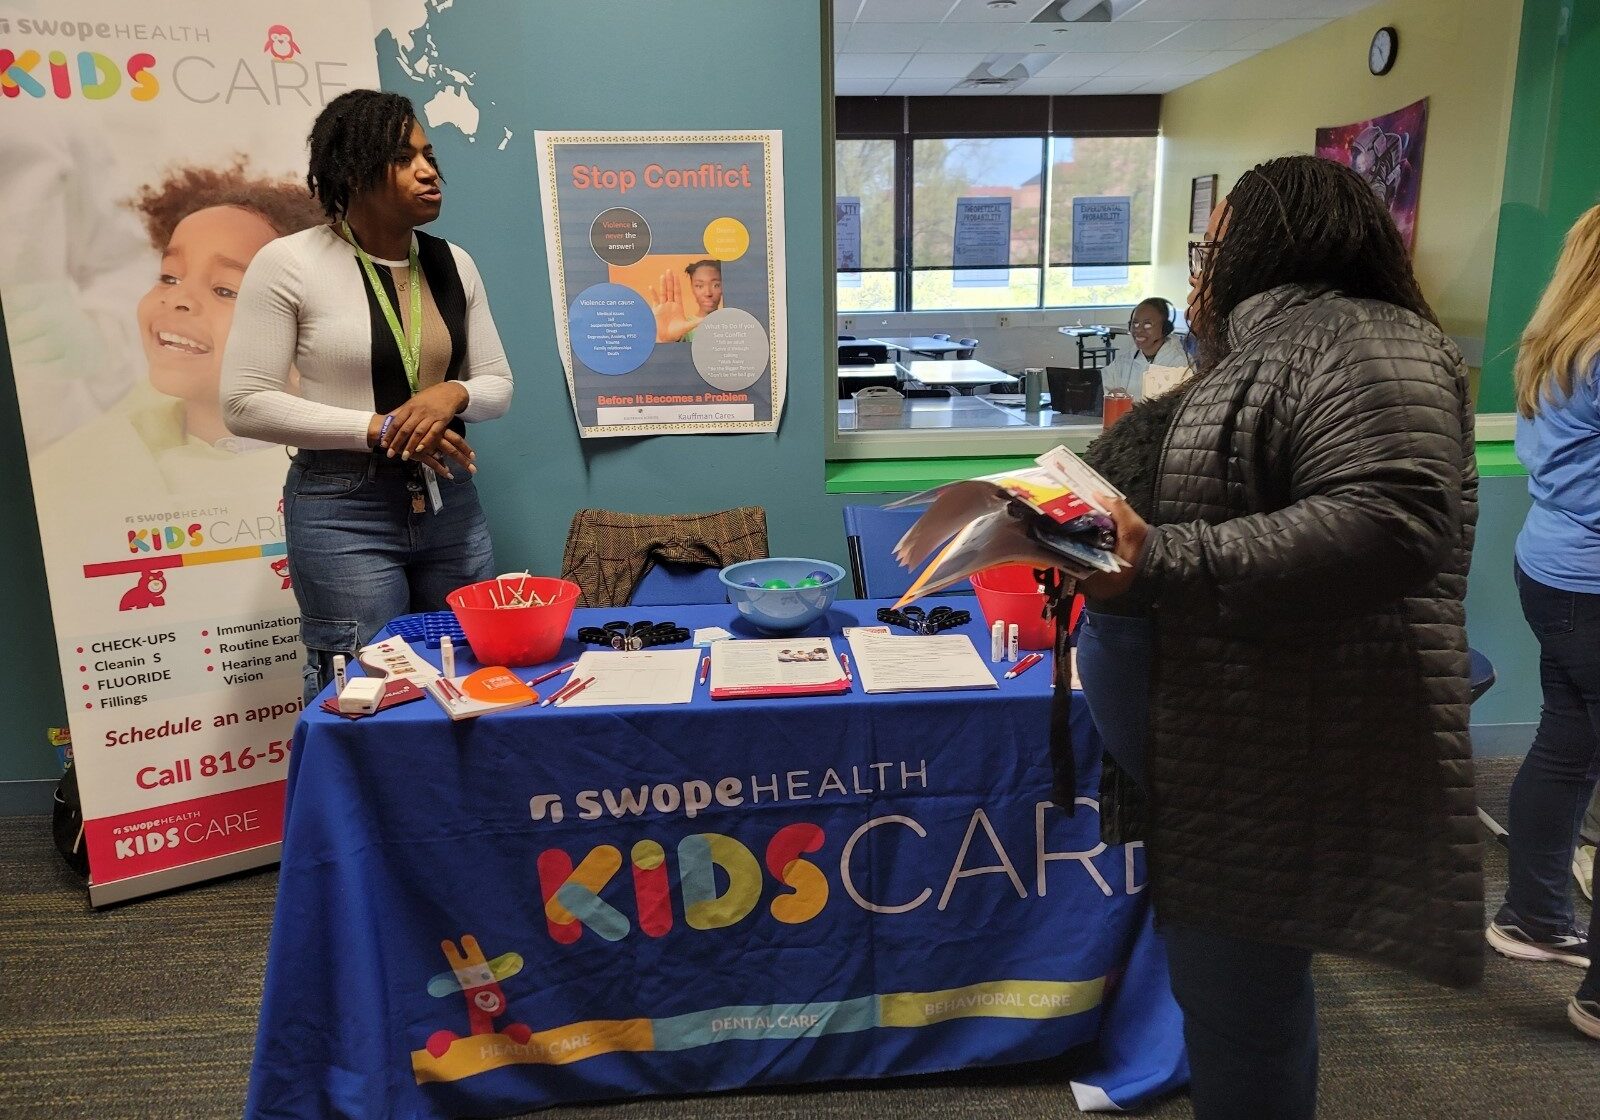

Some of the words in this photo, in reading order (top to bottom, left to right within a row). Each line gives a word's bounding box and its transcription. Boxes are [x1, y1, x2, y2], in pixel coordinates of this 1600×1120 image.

[571, 164, 637, 193] Stop
[643, 163, 752, 189] Conflict
[602, 221, 630, 229] Violence
[963, 213, 1001, 221] PROBABILITY
[1082, 213, 1121, 221] PROBABILITY
[625, 231, 637, 239] the
[744, 323, 755, 331] you
[597, 395, 633, 405] Before
[635, 394, 645, 404] It
[646, 394, 694, 403] Becomes
[705, 393, 748, 402] Problem
[714, 412, 735, 420] Cares
[127, 523, 204, 553] KIDS
[216, 616, 301, 636] Immunization
[91, 632, 176, 653] CHECK-UPS
[219, 638, 270, 653] Routine
[94, 656, 145, 672] Cleanin
[153, 653, 162, 663] S
[222, 656, 272, 672] Hearing
[275, 650, 297, 663] and
[97, 669, 172, 690] FLUORIDE
[223, 671, 264, 685] Vision
[100, 694, 148, 709] Fillings
[104, 716, 202, 747] Schedule
[213, 712, 239, 727] an
[245, 696, 303, 722] appoi
[136, 758, 192, 789] Call
[574, 776, 745, 822] swope
[752, 759, 928, 804] HEALTH
[114, 827, 180, 860] KIDS
[183, 809, 260, 843] CARE
[537, 822, 830, 945] KIDS
[925, 993, 1025, 1016] BEHAVIORAL
[1028, 993, 1071, 1008] CARE
[712, 1016, 775, 1032] DENTAL
[777, 1014, 820, 1029] CARE
[480, 1043, 545, 1060] HEALTH
[549, 1033, 592, 1056] CARE
